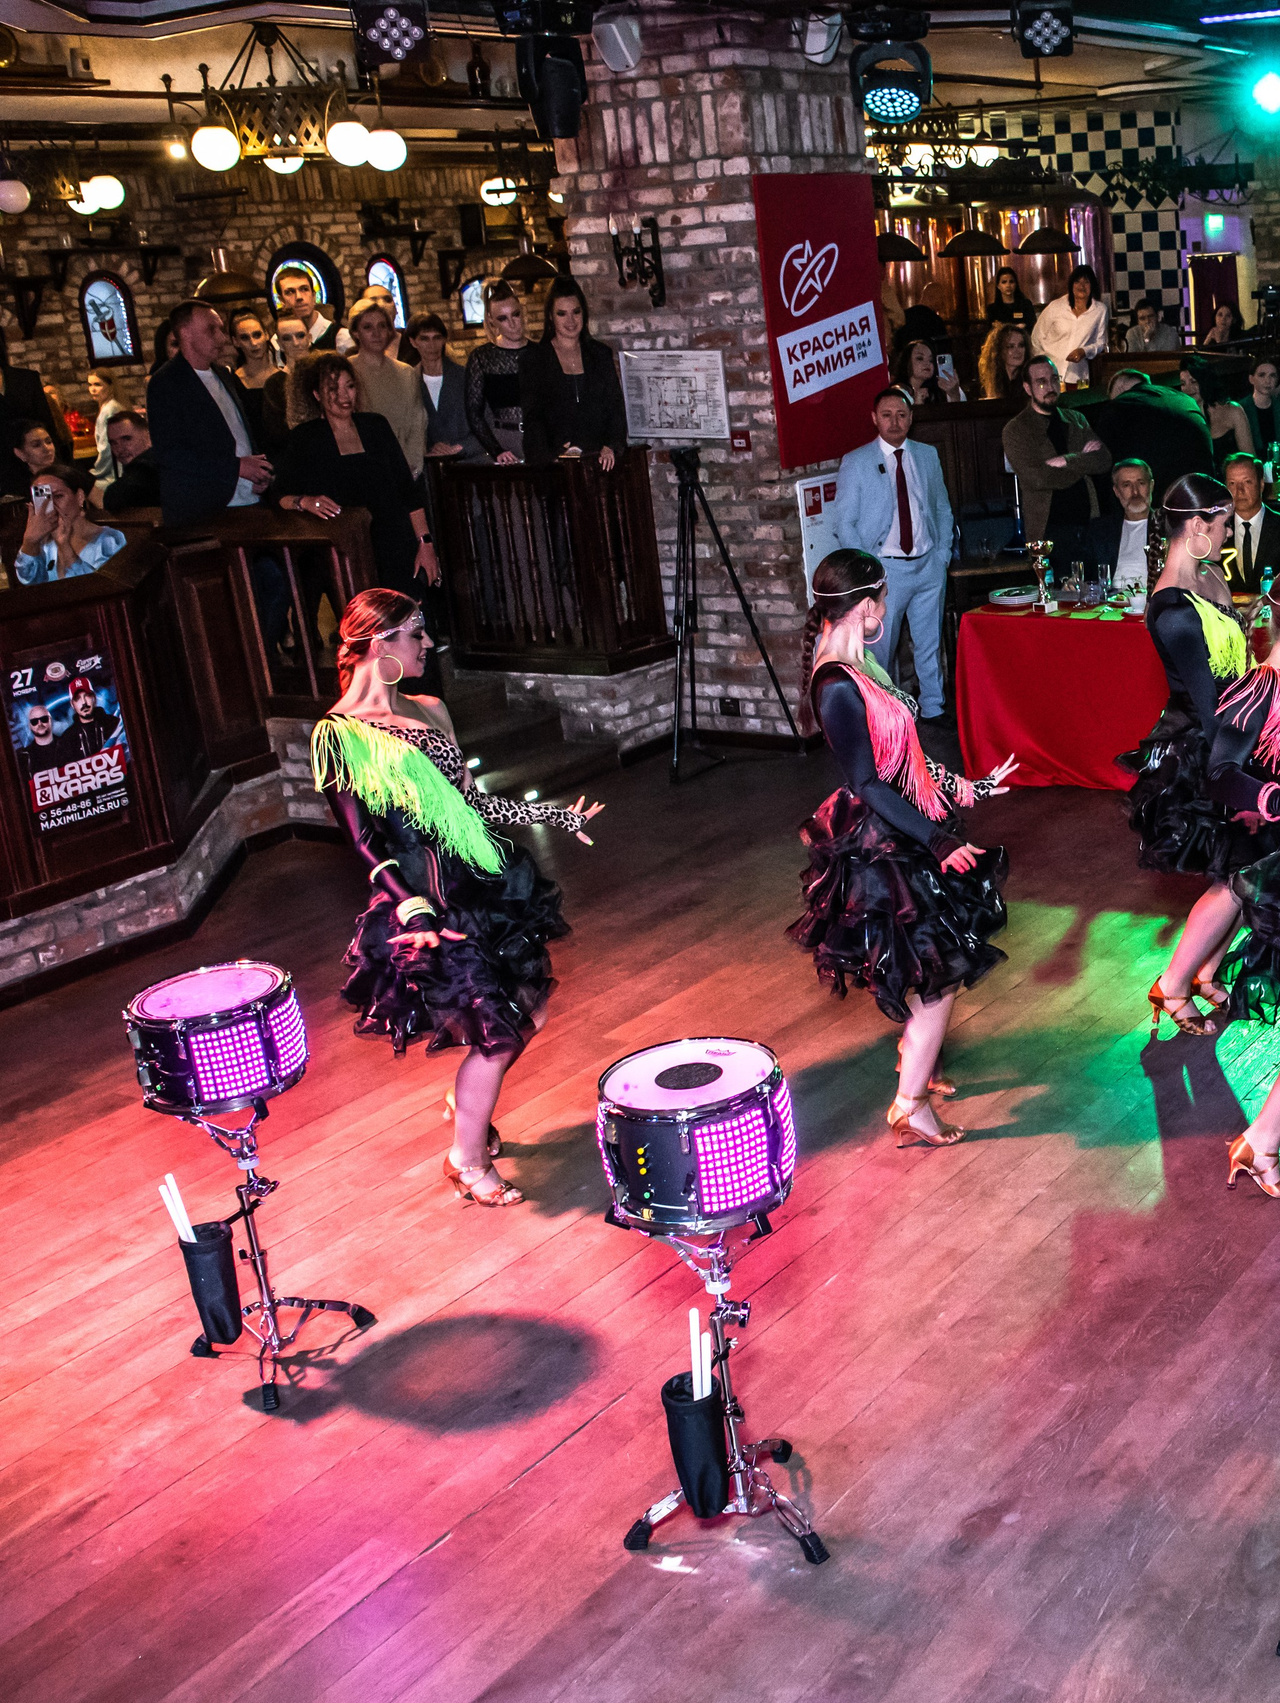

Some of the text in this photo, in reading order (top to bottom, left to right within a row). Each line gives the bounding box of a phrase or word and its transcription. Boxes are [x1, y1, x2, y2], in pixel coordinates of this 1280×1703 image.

[786, 315, 871, 365] КРАСНАЯ
[855, 337, 872, 351] 104.6
[857, 349, 868, 361] FM
[793, 346, 856, 389] АРМИЯ
[10, 667, 34, 690] 27
[12, 686, 38, 698] НОЯБРЯ
[33, 748, 120, 790] FILATOV
[40, 799, 120, 831] MAXIMILIANS.RU
[50, 798, 92, 818] 56-48-86
